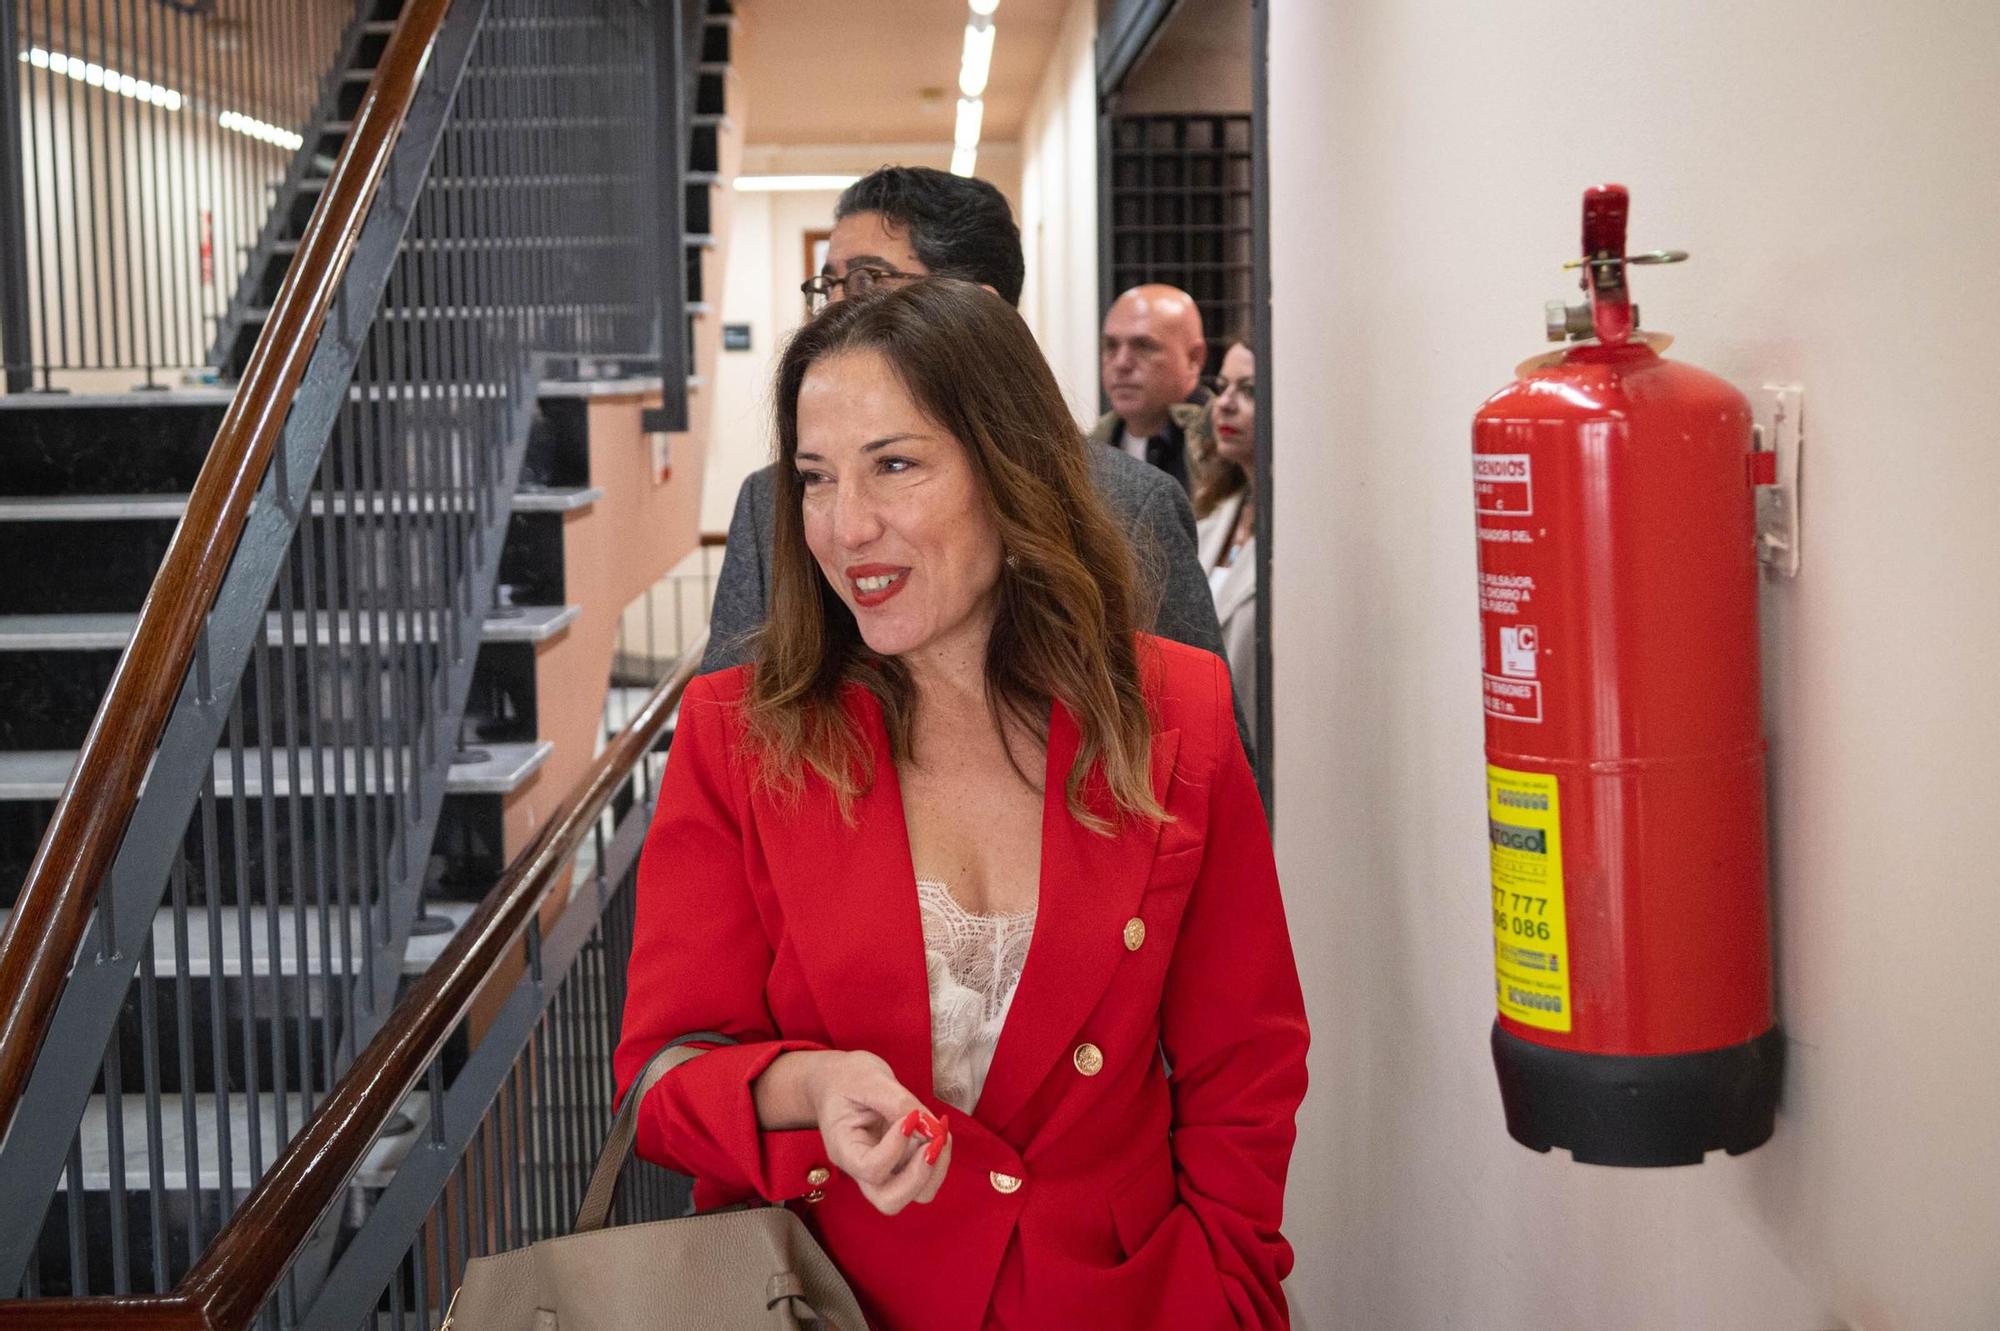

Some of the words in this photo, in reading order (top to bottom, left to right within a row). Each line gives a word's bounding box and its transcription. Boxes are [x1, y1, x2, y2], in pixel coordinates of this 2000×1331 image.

[1522, 590, 1531, 602] A
[1518, 627, 1535, 650] C
[1511, 892, 1548, 915] 777
[1512, 916, 1551, 940] 086
